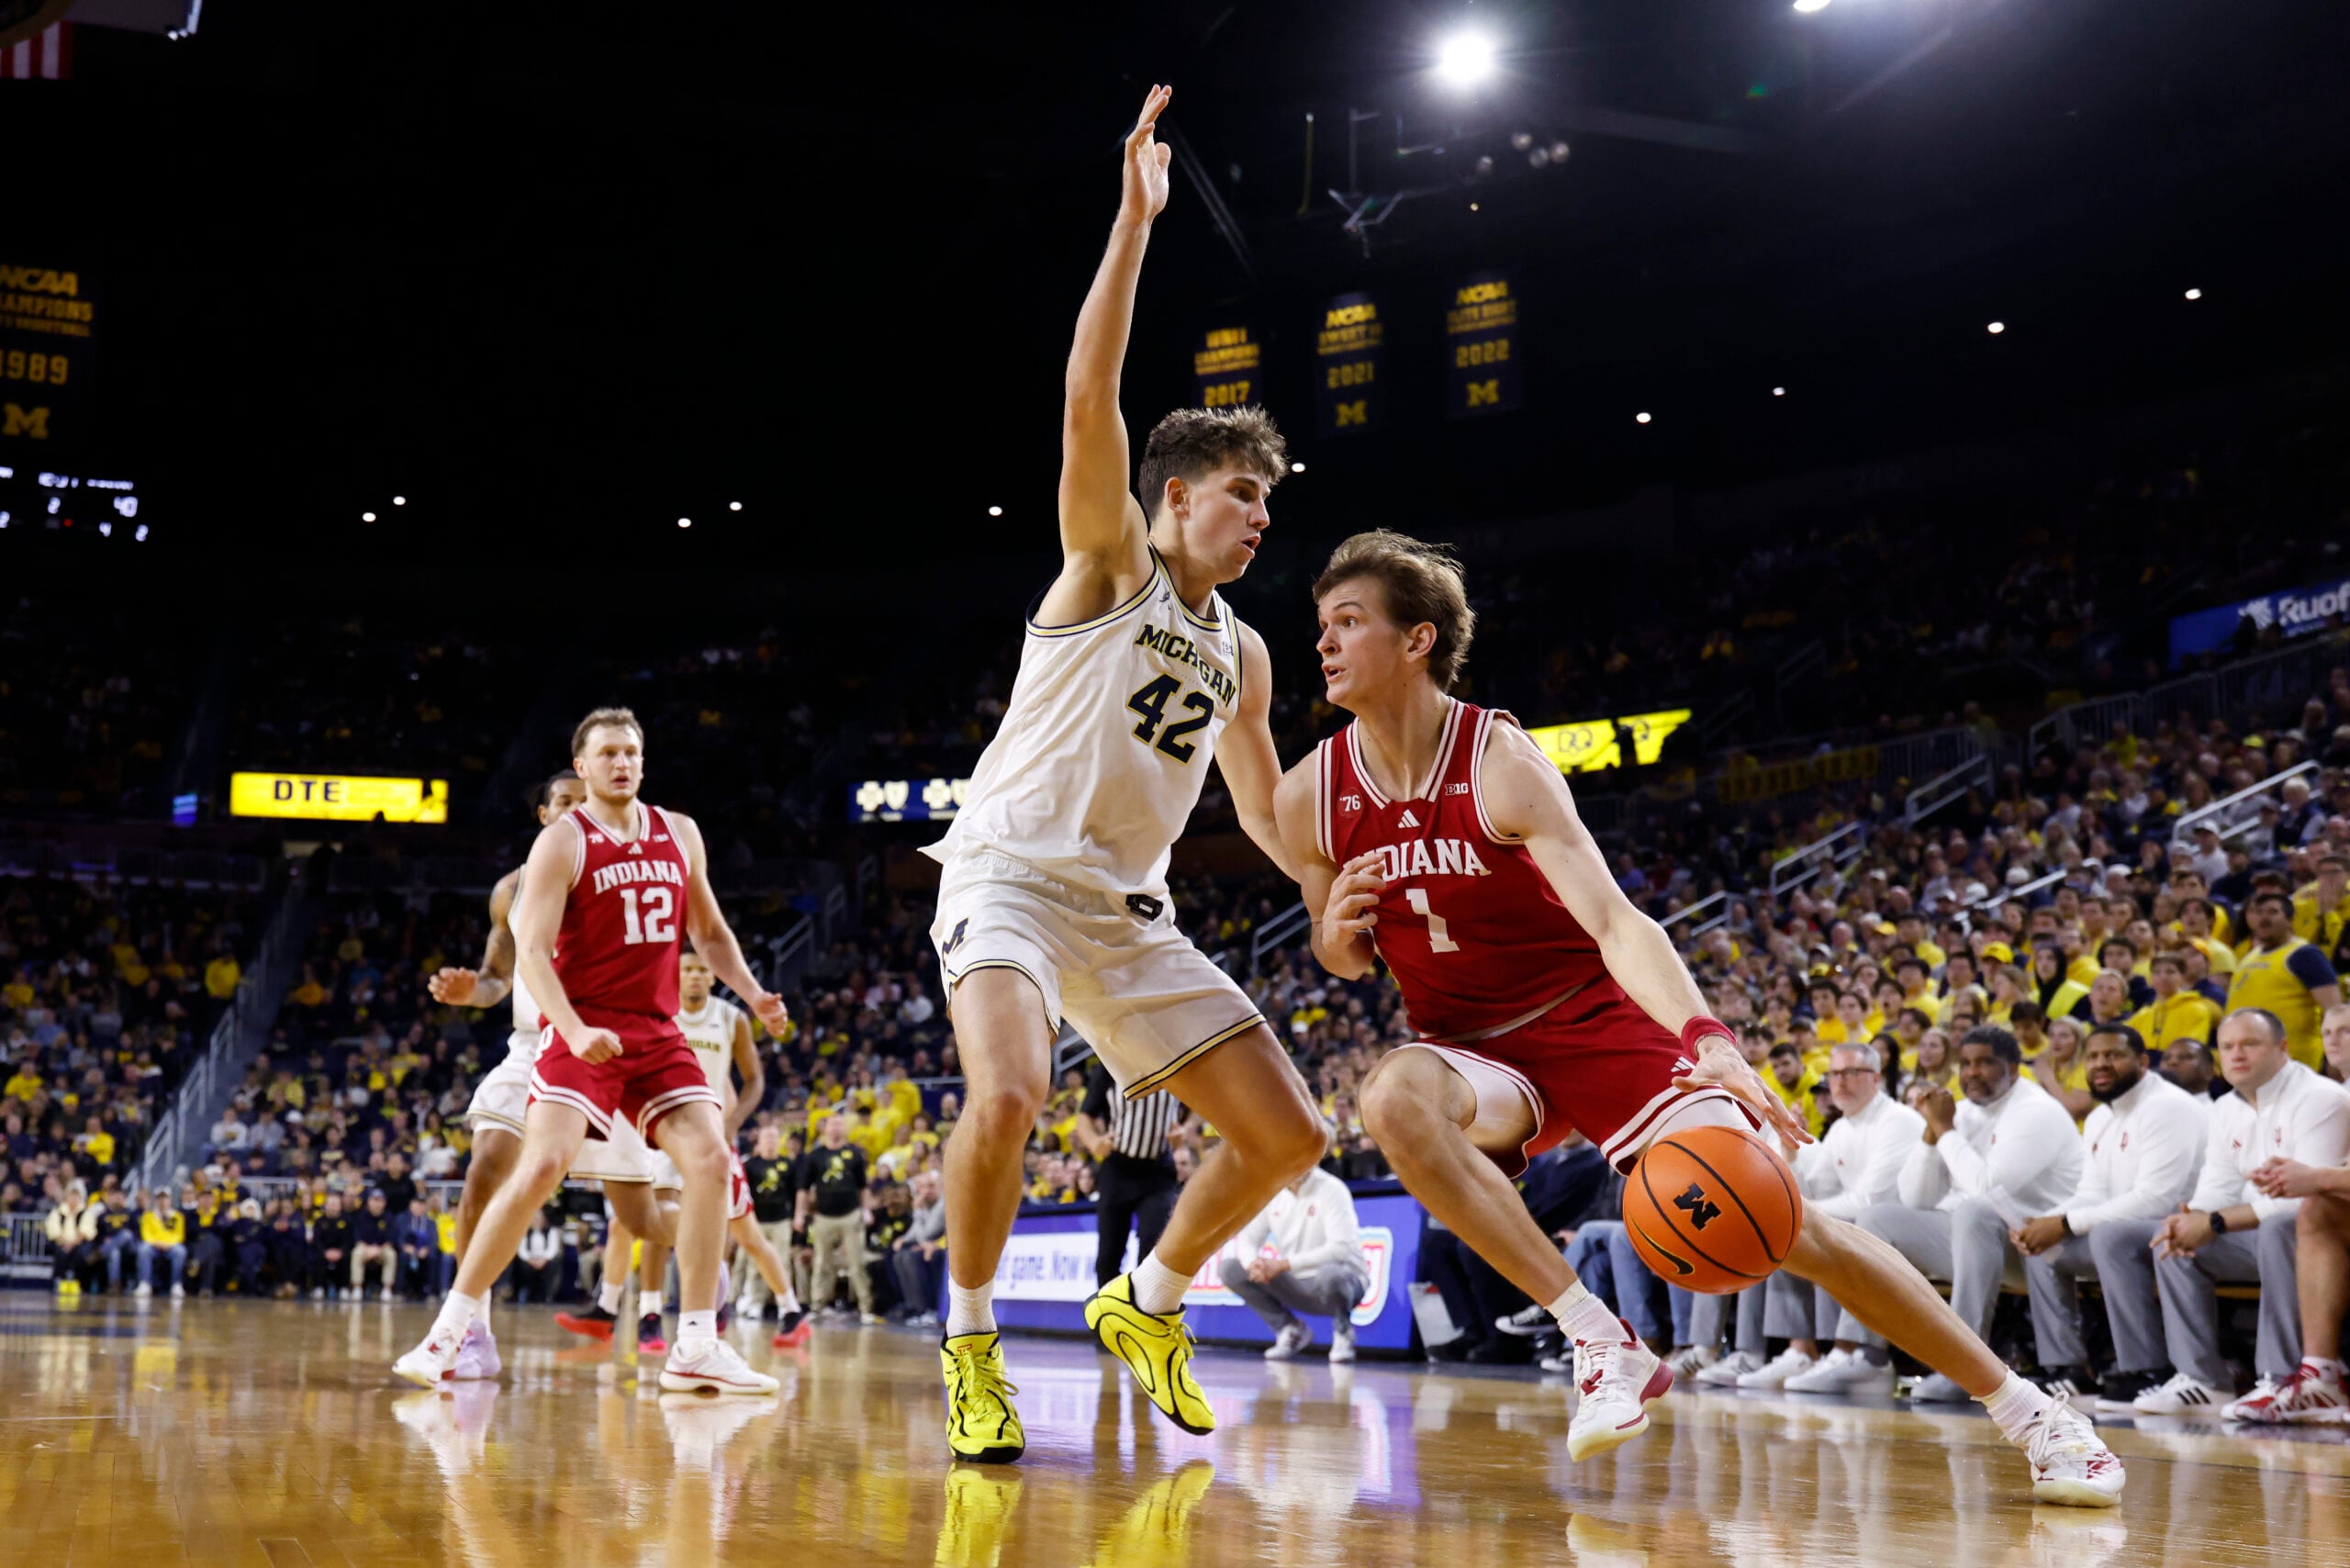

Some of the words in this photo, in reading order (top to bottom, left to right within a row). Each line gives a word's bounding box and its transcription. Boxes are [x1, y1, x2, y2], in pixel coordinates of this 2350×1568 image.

[1335, 399, 1367, 428] M
[1466, 378, 1500, 408] M
[1, 401, 51, 441] M
[1135, 623, 1237, 708] MICHGAN
[1126, 672, 1214, 764] 42
[274, 779, 341, 802] DTE
[592, 859, 684, 896] INDIANA
[1343, 838, 1493, 883] DIANA
[620, 886, 677, 946] 12
[1405, 888, 1461, 954] 1
[1673, 1182, 1722, 1231] M
